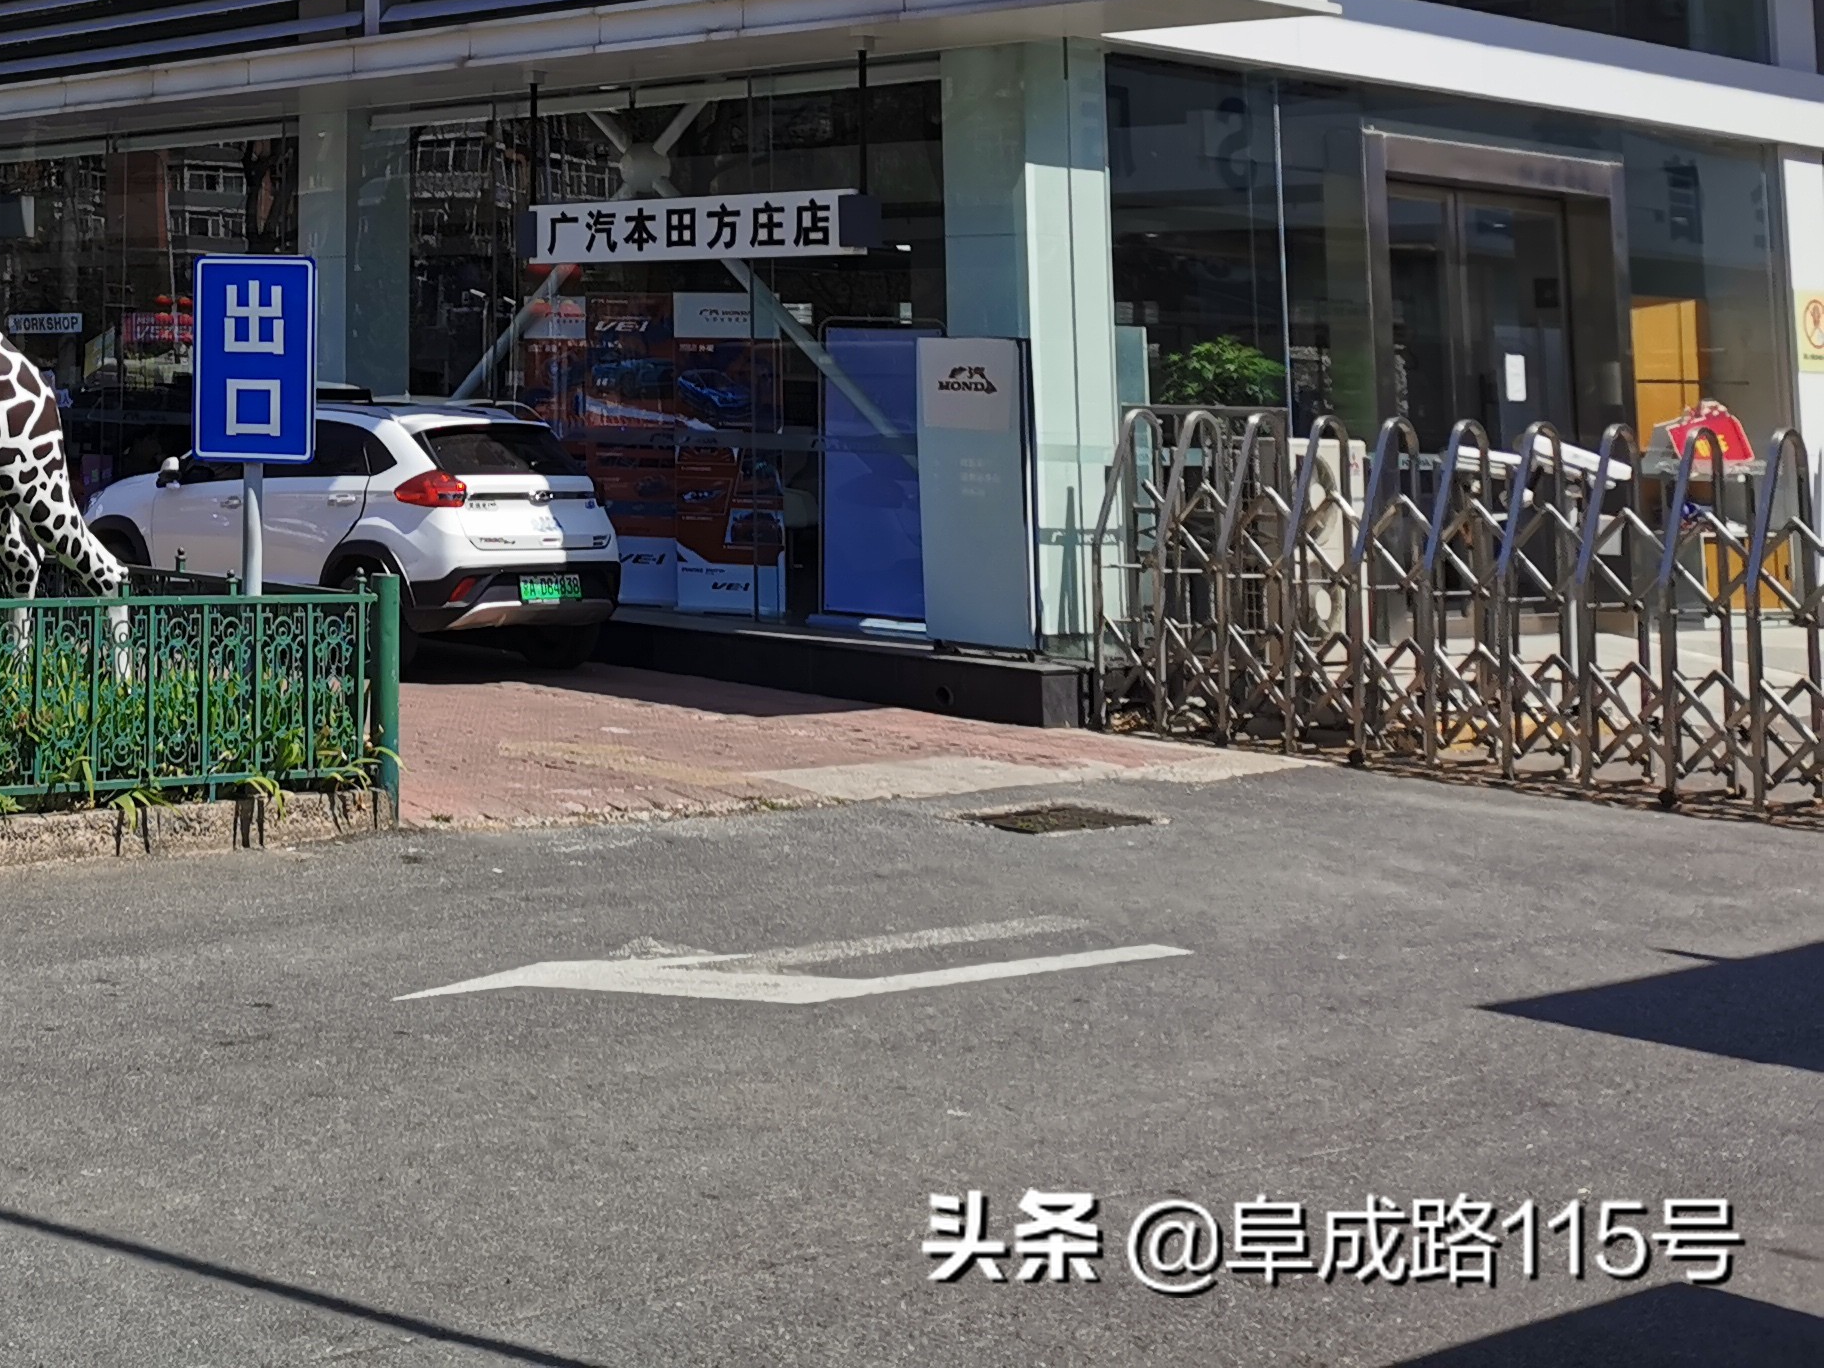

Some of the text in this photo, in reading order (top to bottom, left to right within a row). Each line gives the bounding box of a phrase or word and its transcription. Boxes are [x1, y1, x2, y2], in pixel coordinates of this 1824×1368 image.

[547, 198, 831, 256] 广汽本田方庄店
[13, 315, 79, 331] WORKSHOP
[223, 279, 285, 438] 出口
